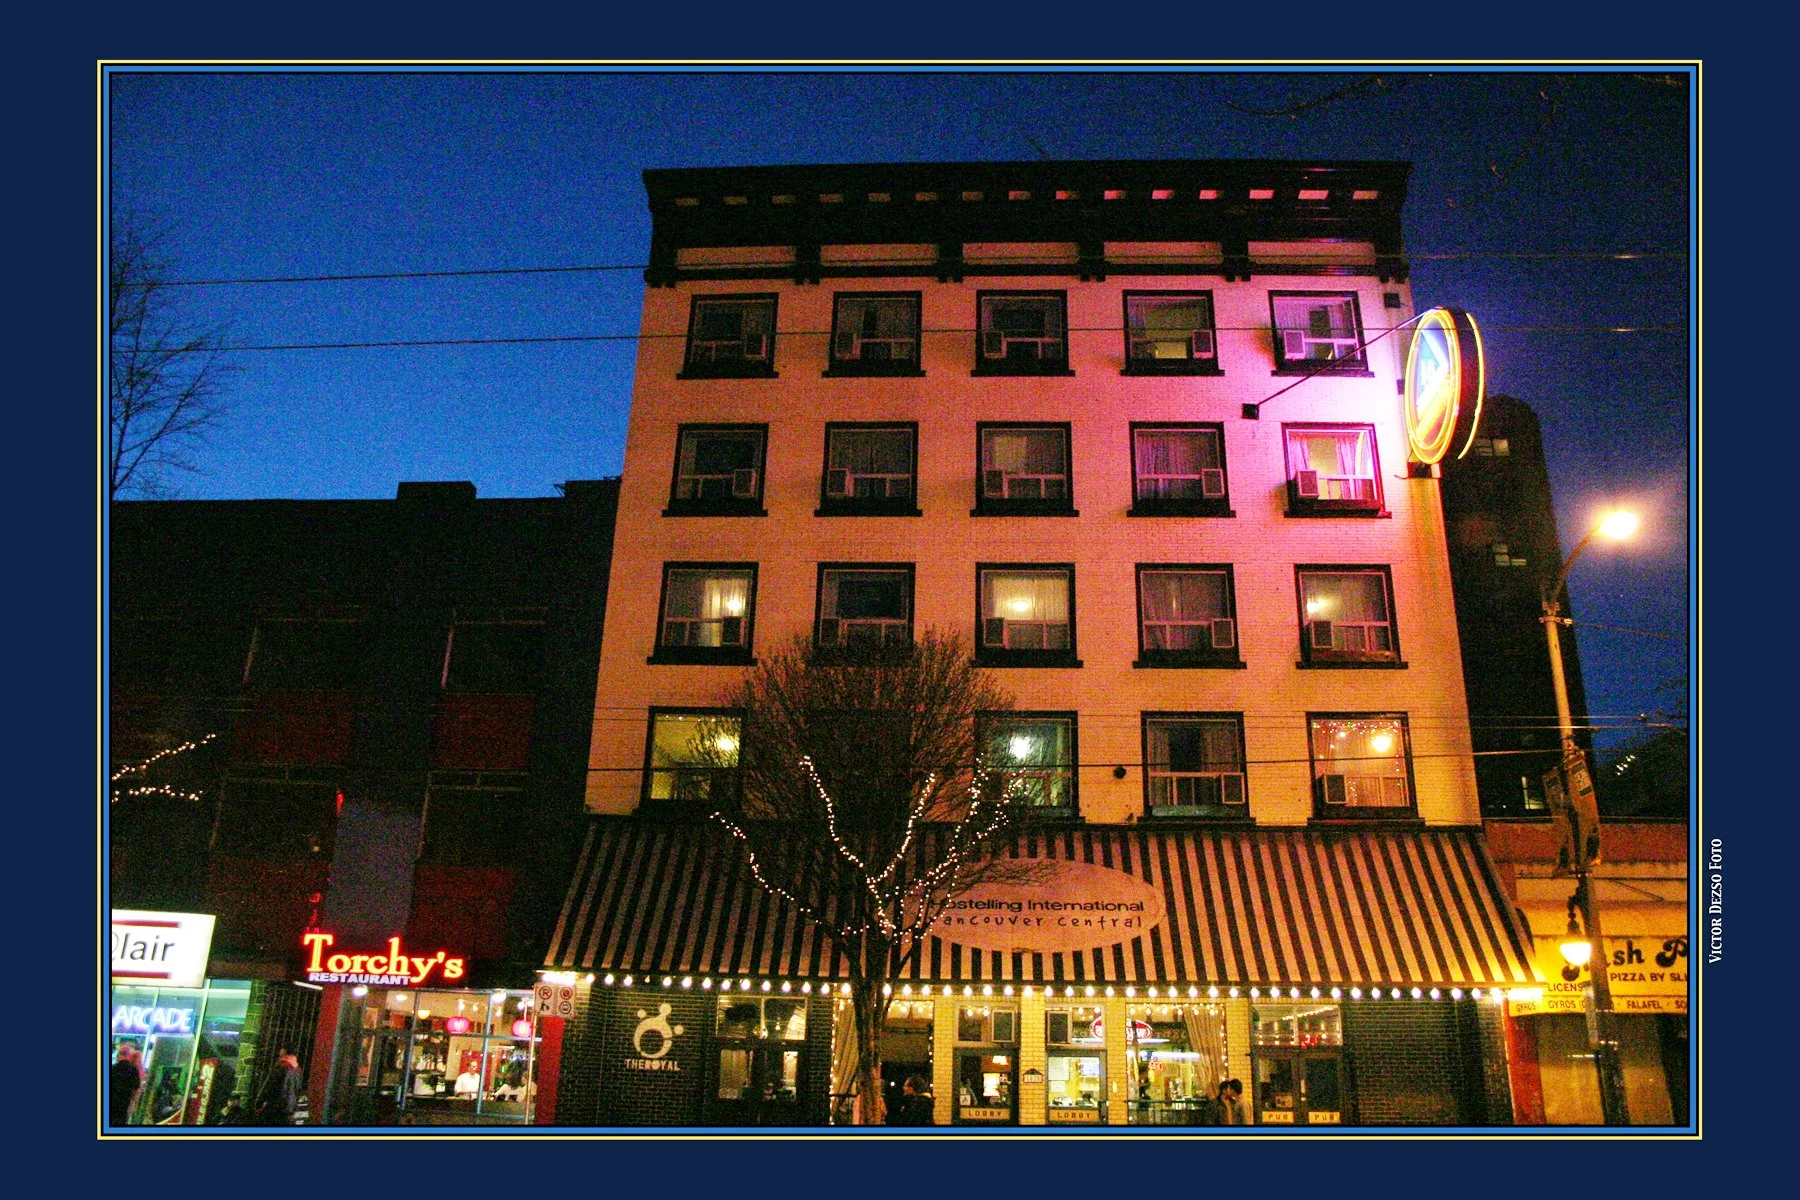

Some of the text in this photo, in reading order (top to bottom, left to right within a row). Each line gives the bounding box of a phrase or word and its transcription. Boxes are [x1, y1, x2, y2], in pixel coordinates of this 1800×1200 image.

[1028, 900, 1145, 913] International
[931, 915, 1142, 930] ancouver central
[303, 933, 465, 984] Torchy's
[308, 972, 412, 986] RESTAURANT
[1610, 972, 1647, 982] PIZZA
[1650, 972, 1665, 982] BY
[1549, 1000, 1577, 1009] GYROS
[1626, 1000, 1663, 1009] FALAFEL
[112, 1005, 194, 1030] ARCADE
[968, 1109, 1002, 1118] LOBBY
[1057, 1111, 1091, 1119] LOBBY
